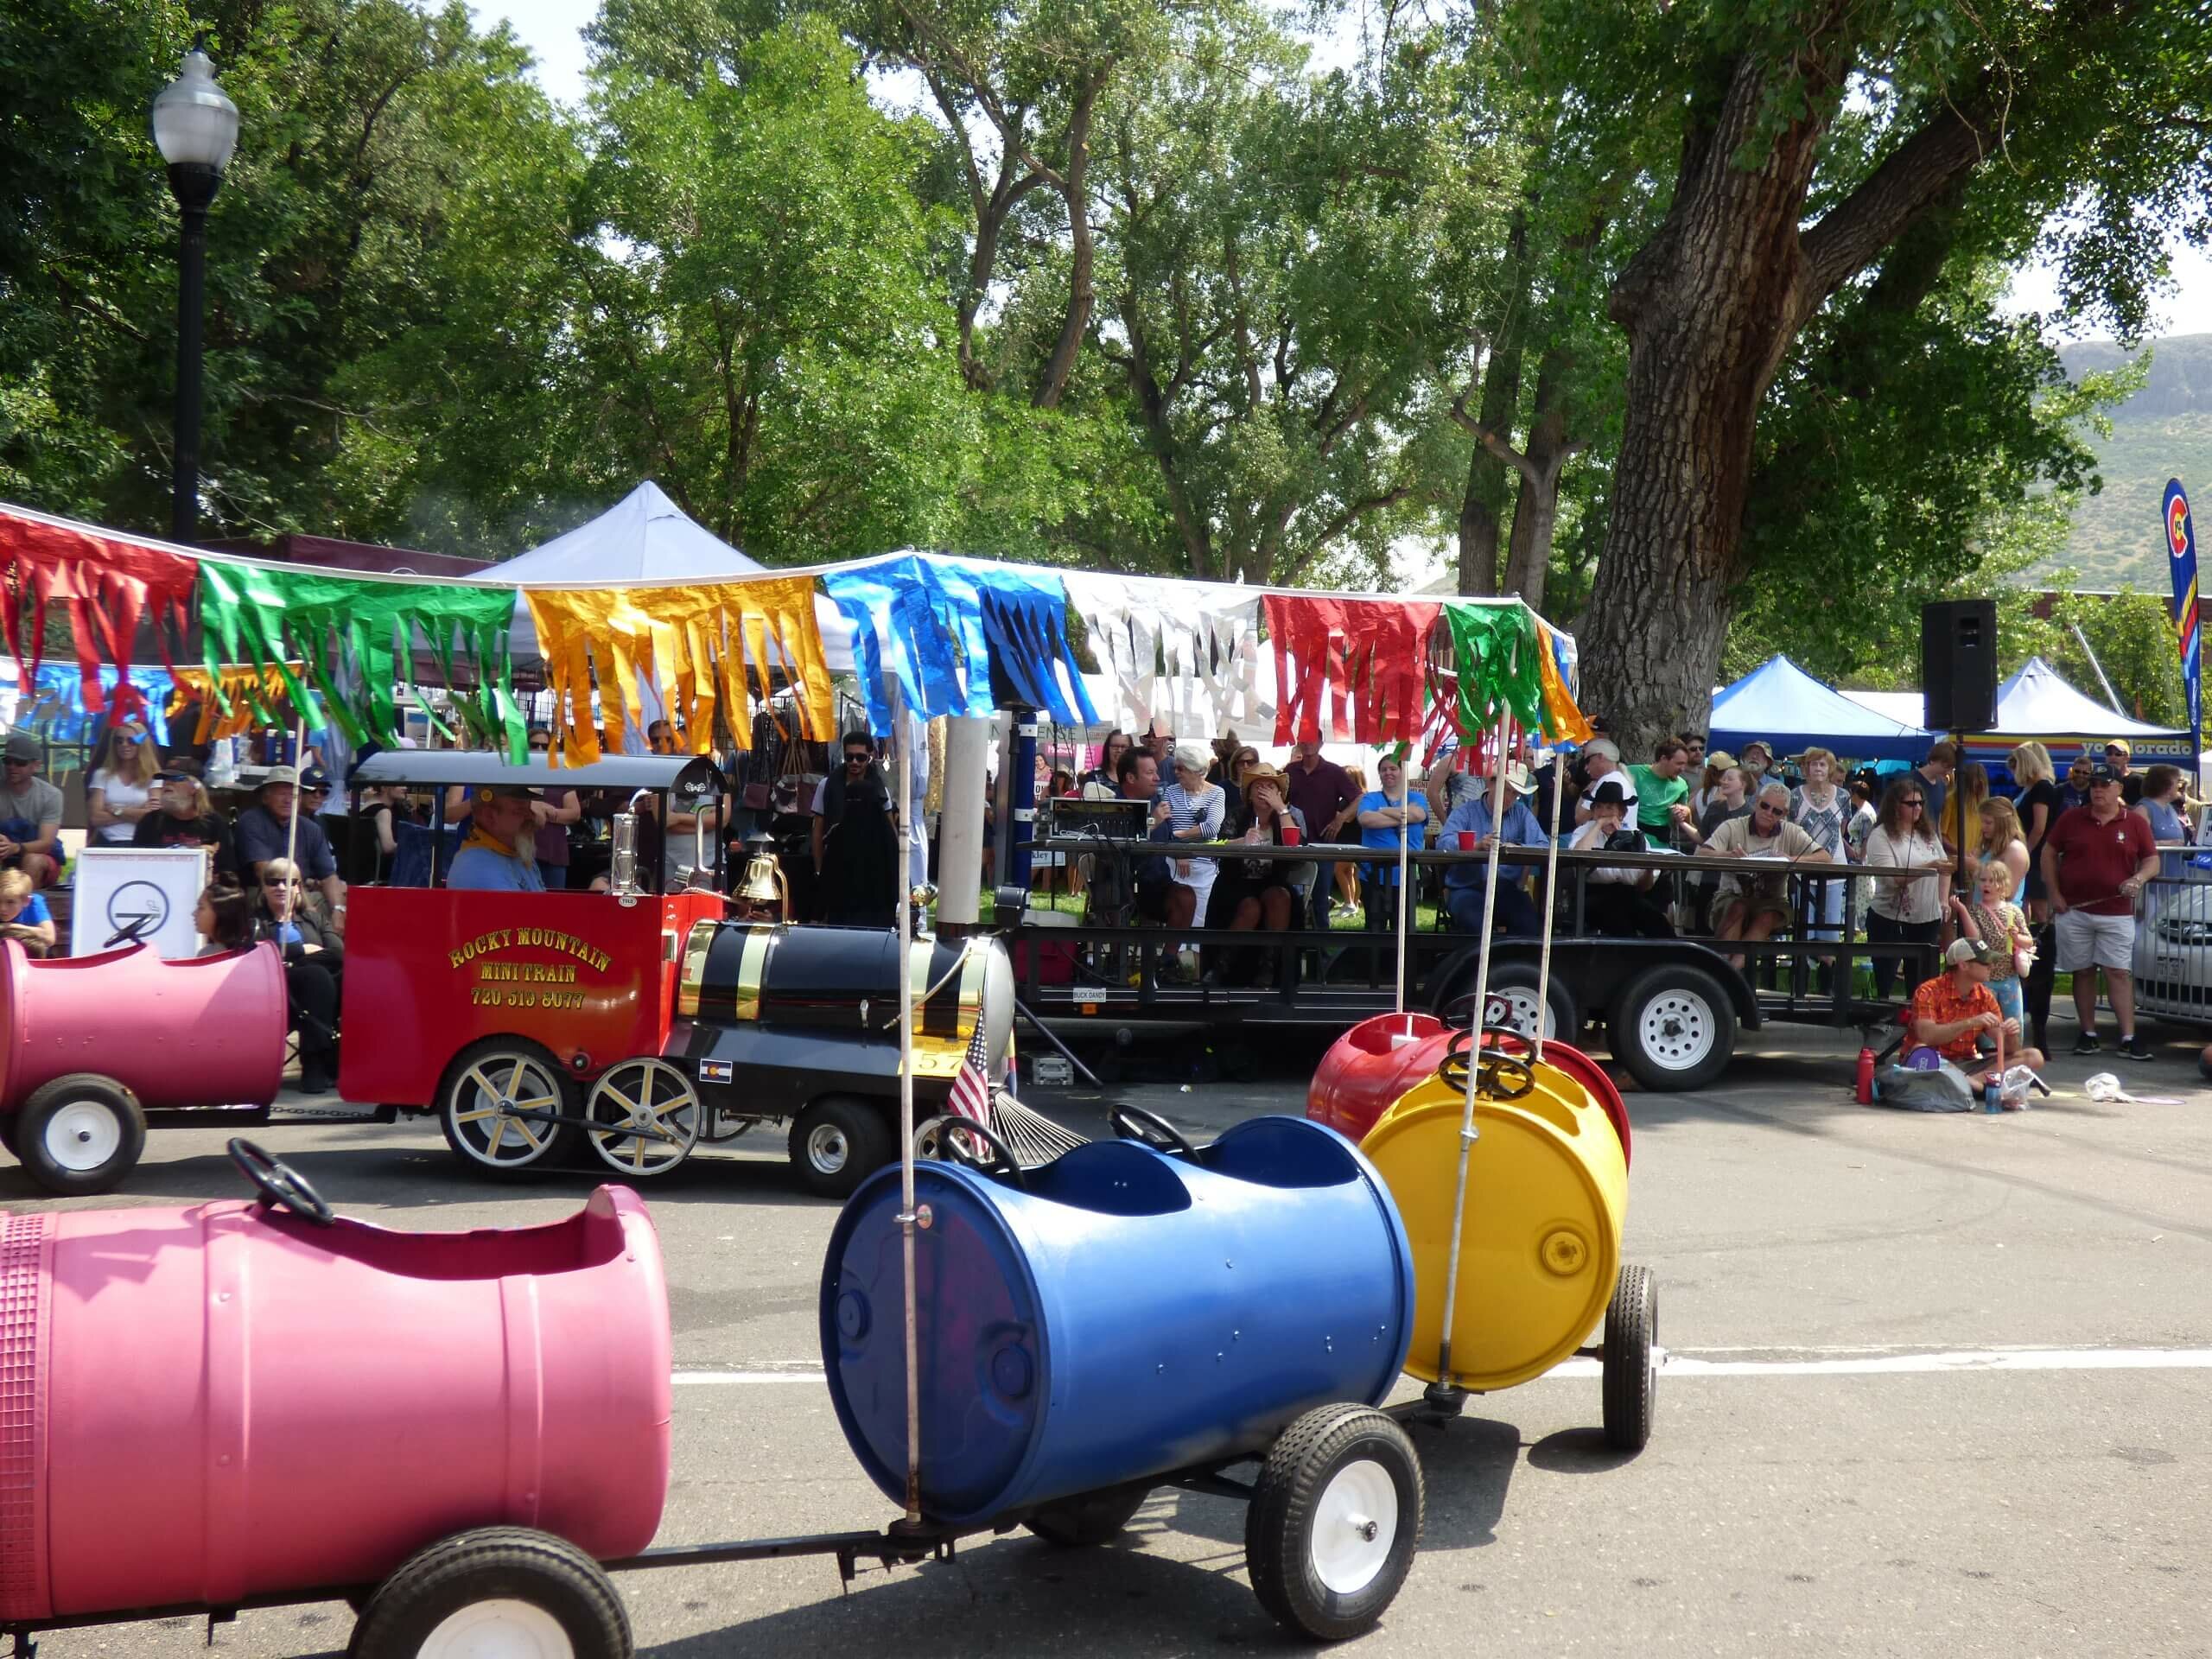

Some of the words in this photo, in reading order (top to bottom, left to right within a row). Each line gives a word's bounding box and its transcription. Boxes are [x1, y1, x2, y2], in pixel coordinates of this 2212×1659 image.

[2081, 740, 2192, 756] yolorado
[448, 929, 512, 969] ROCKY
[517, 927, 612, 973] MOUNTAIN
[480, 961, 519, 982] MINI
[524, 963, 577, 983] TRAIN
[918, 1053, 964, 1070] 57
